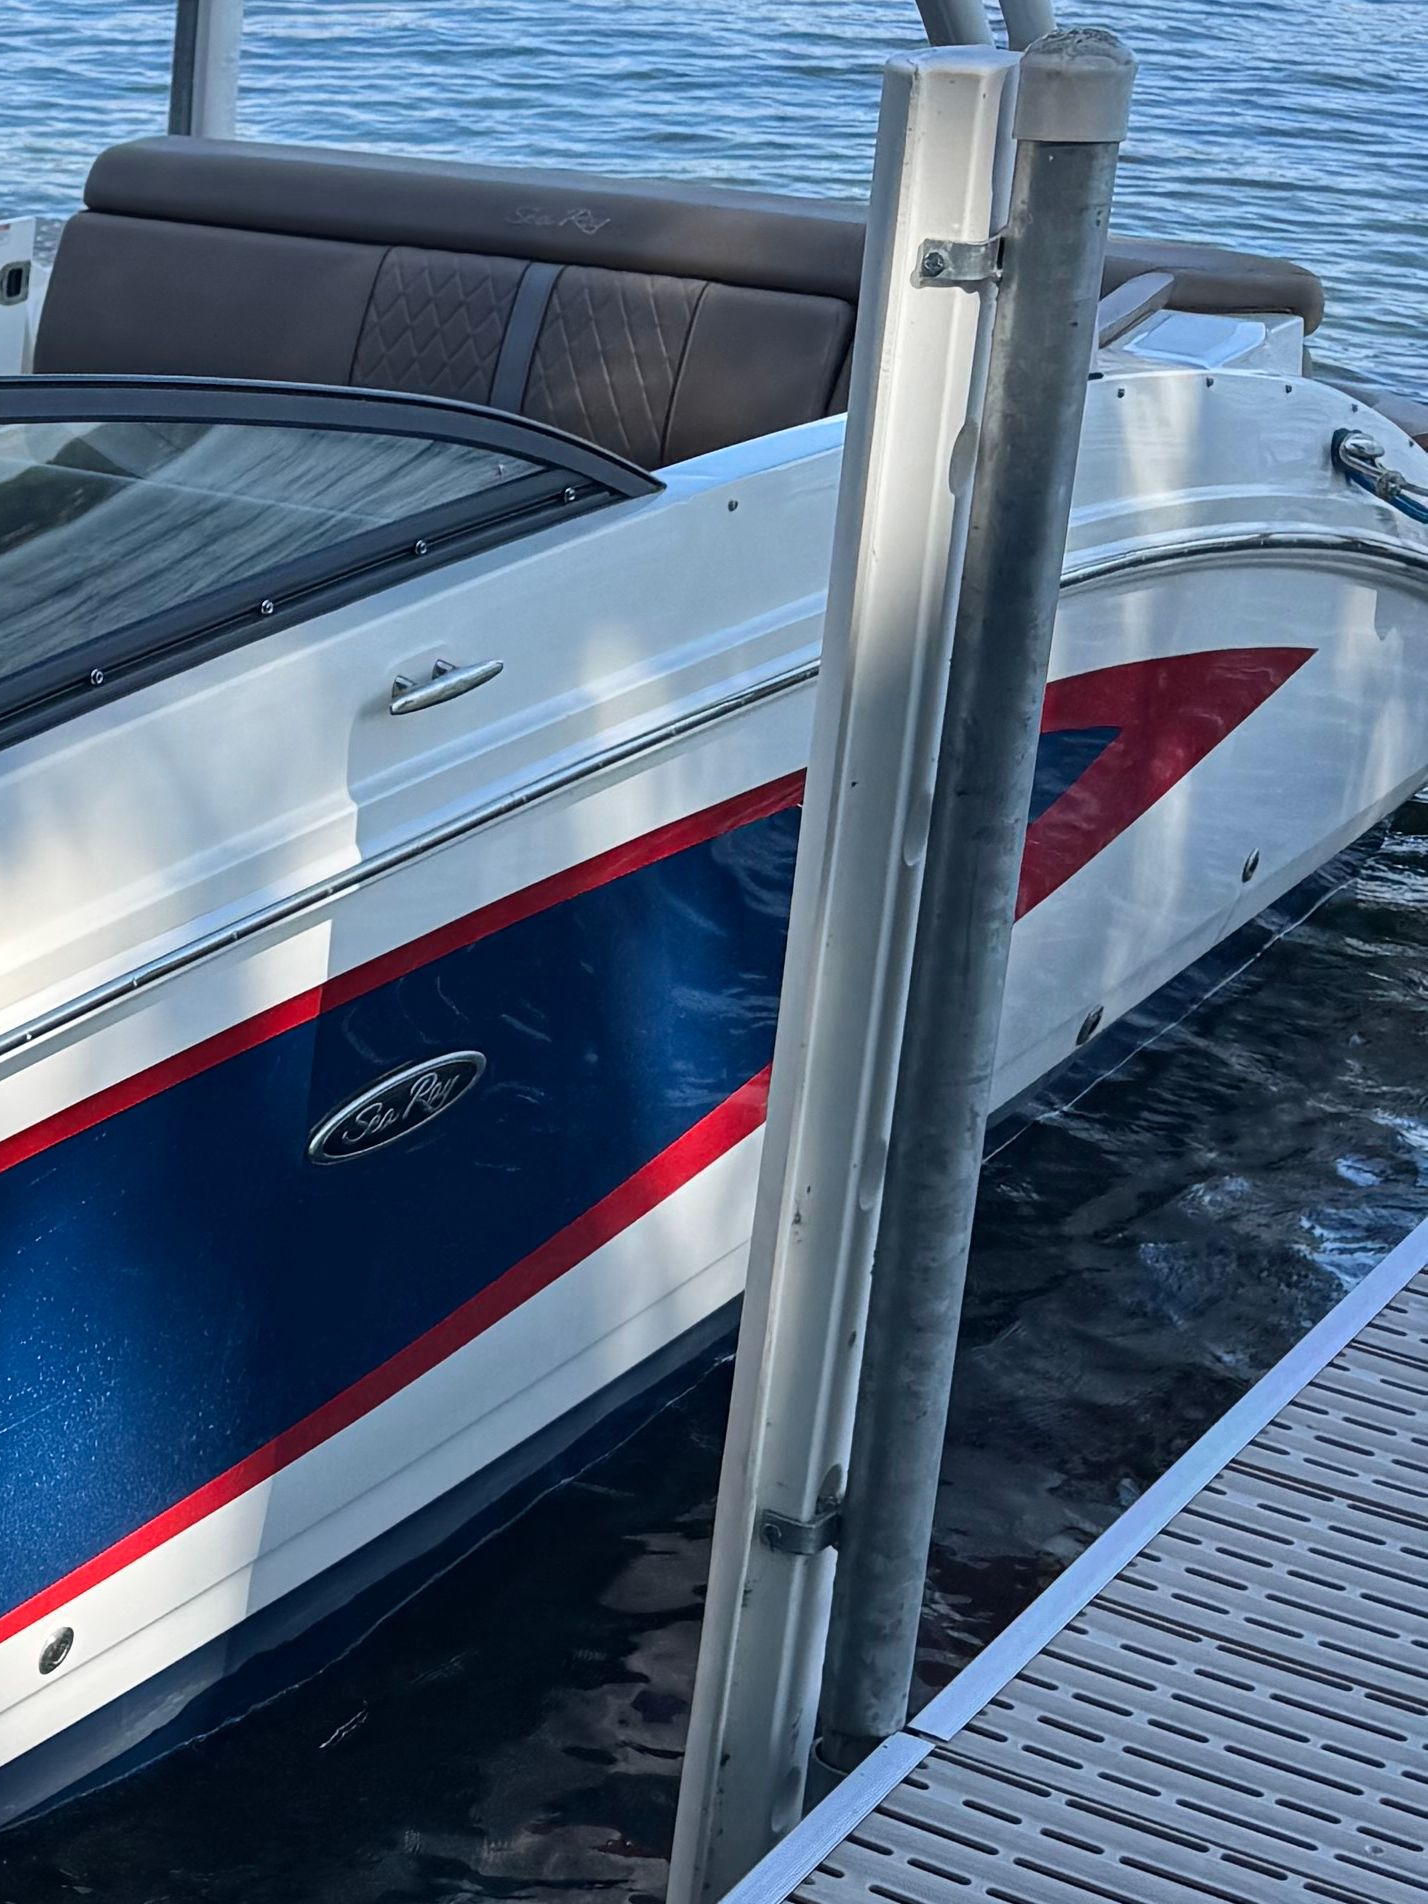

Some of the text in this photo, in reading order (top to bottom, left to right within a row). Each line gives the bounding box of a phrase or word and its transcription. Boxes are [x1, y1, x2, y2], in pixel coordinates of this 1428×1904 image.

[558, 207, 611, 235] Ray
[342, 1072, 460, 1142] Sea Ray
